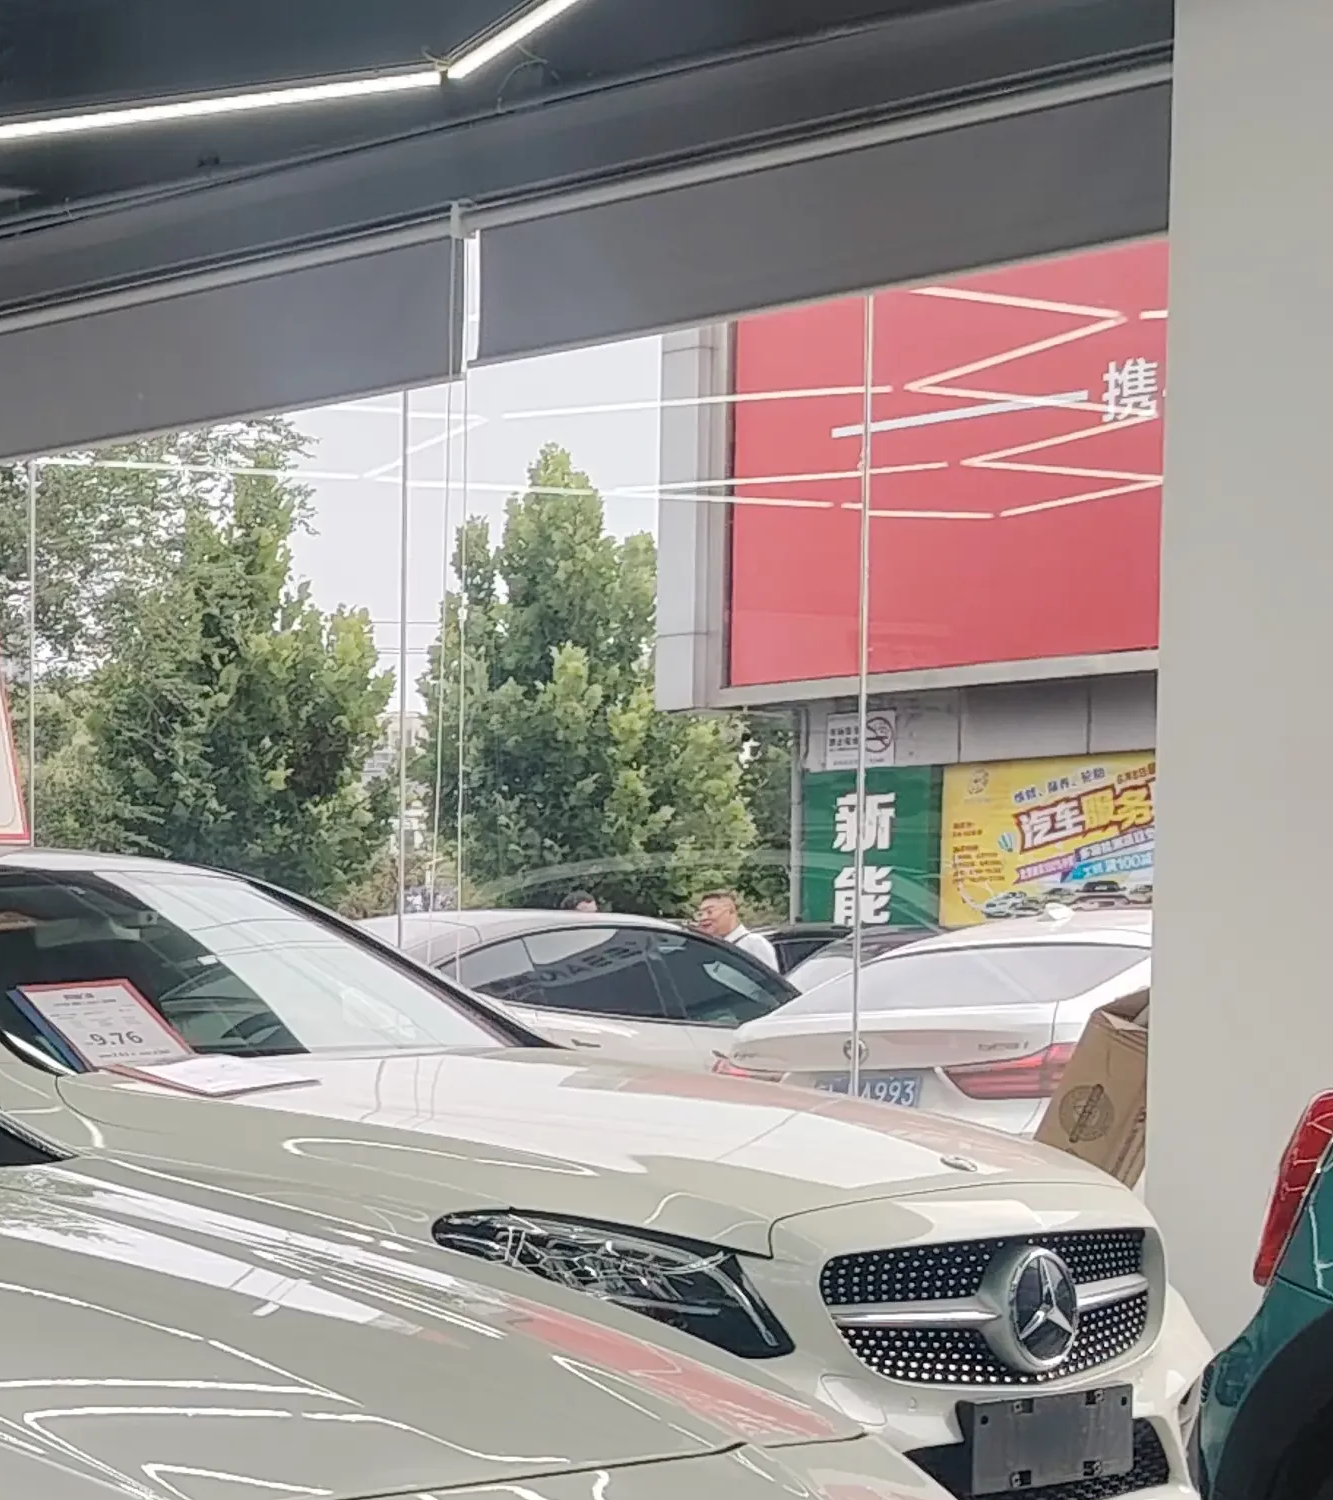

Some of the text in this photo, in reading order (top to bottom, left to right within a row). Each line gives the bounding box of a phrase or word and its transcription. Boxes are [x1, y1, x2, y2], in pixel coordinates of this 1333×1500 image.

[1101, 357, 1166, 423] 携
[1017, 785, 1155, 853] 汽车服务
